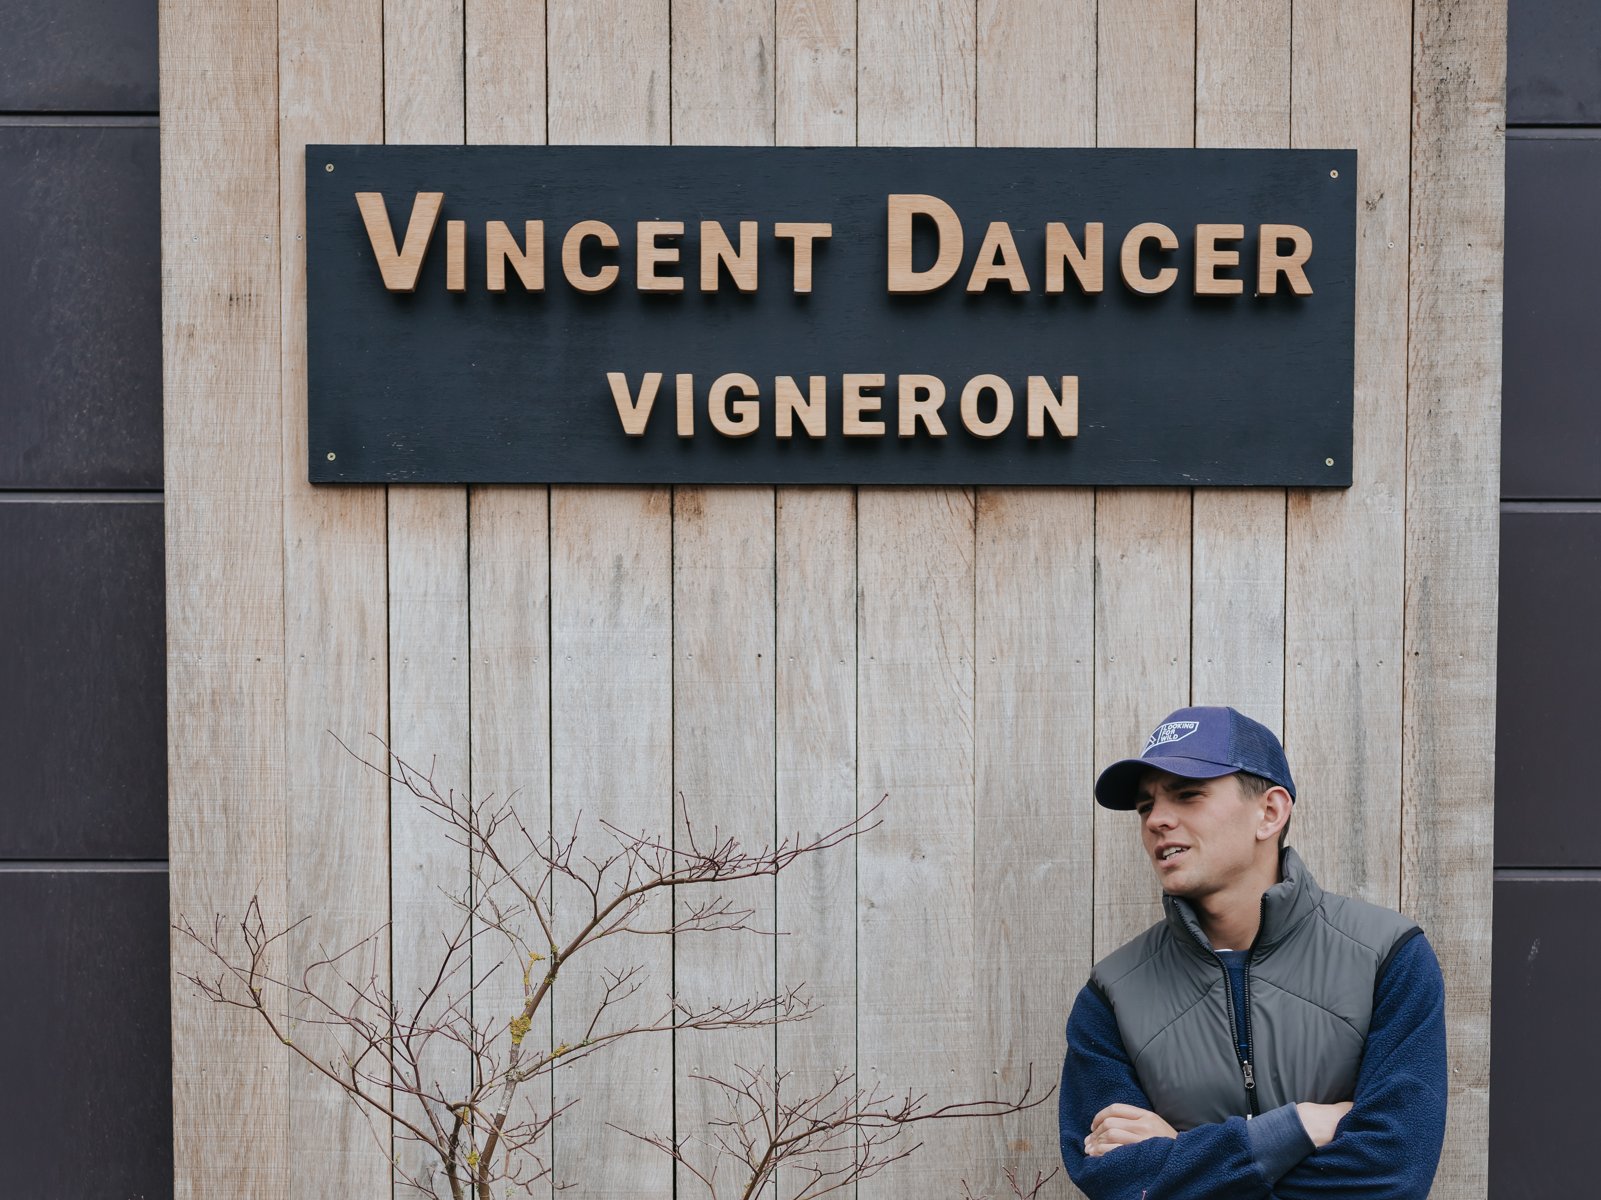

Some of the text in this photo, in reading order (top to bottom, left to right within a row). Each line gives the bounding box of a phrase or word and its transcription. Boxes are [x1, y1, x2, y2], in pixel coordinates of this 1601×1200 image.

[355, 191, 1315, 297] VINCENT DANCER
[607, 371, 1080, 440] VIGNERON
[1162, 728, 1175, 736] FOR
